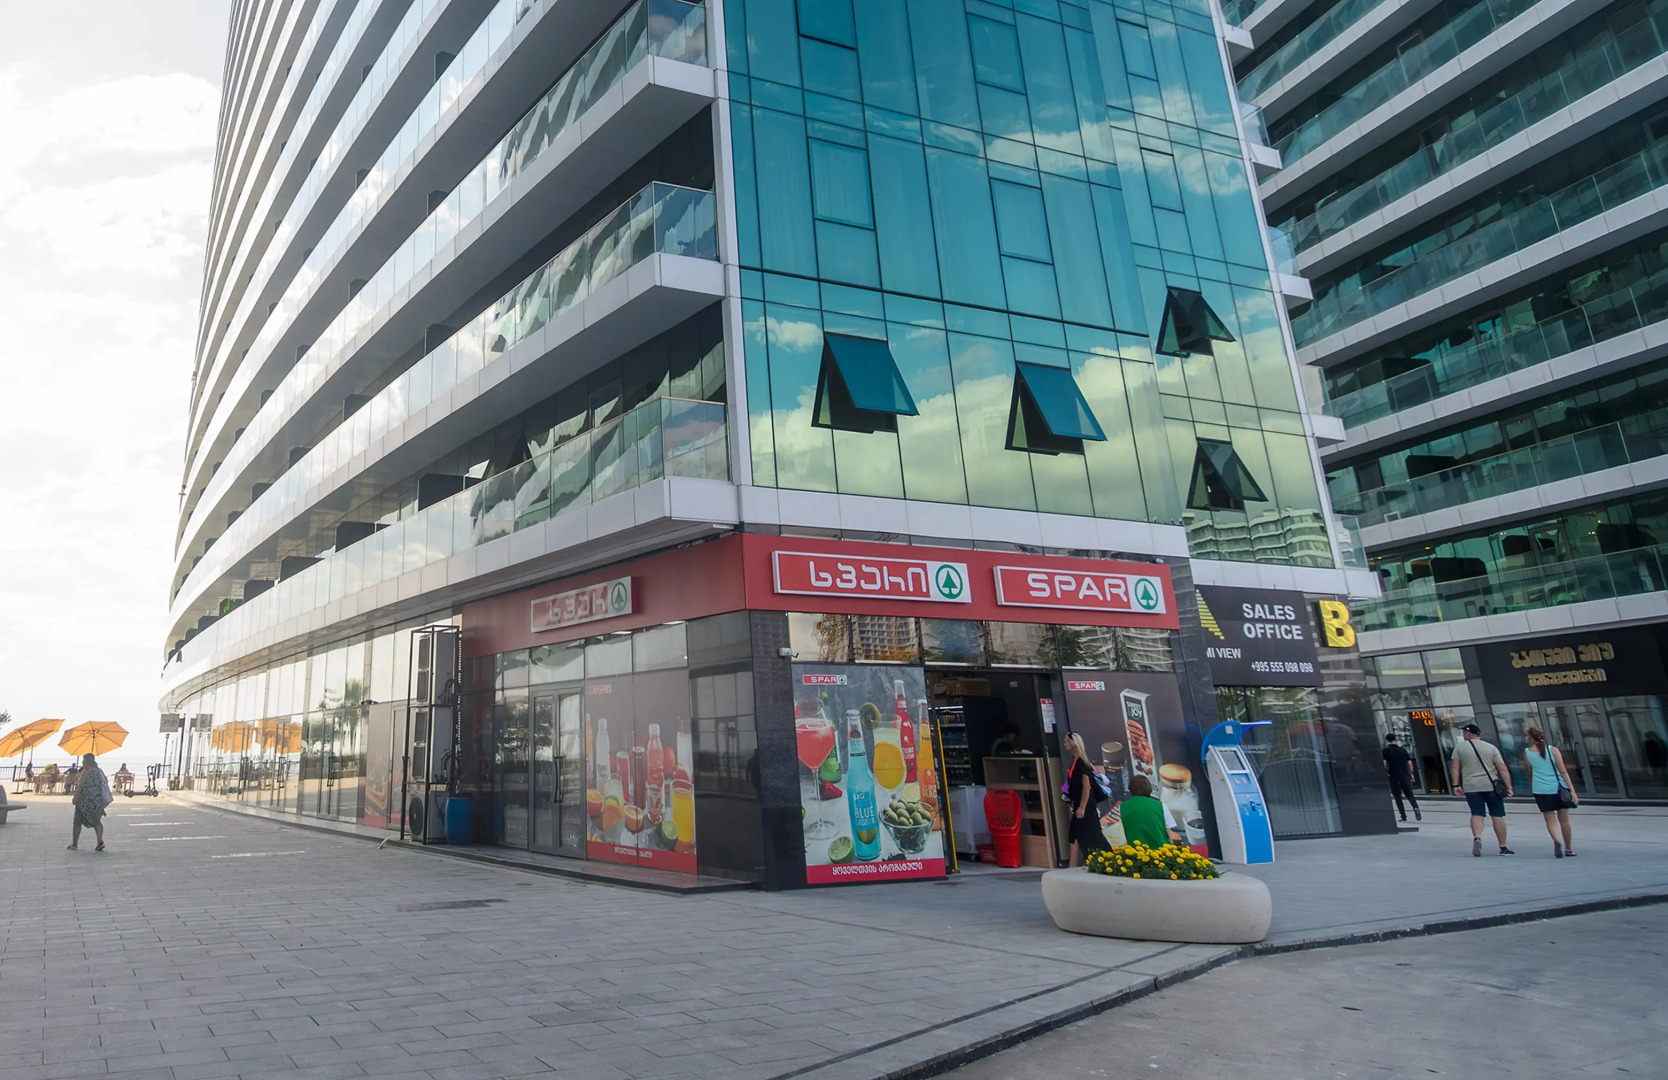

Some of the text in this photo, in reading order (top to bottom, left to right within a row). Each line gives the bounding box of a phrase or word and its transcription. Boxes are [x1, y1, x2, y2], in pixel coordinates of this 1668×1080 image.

[1027, 572, 1128, 603] SPAR
[1242, 603, 1296, 621] SALES
[1243, 623, 1304, 640] OFFICE
[1317, 600, 1356, 648] B
[1216, 647, 1242, 659] VIEW
[1251, 661, 1314, 673] +995 555 098 098
[854, 806, 875, 818] BLUE
